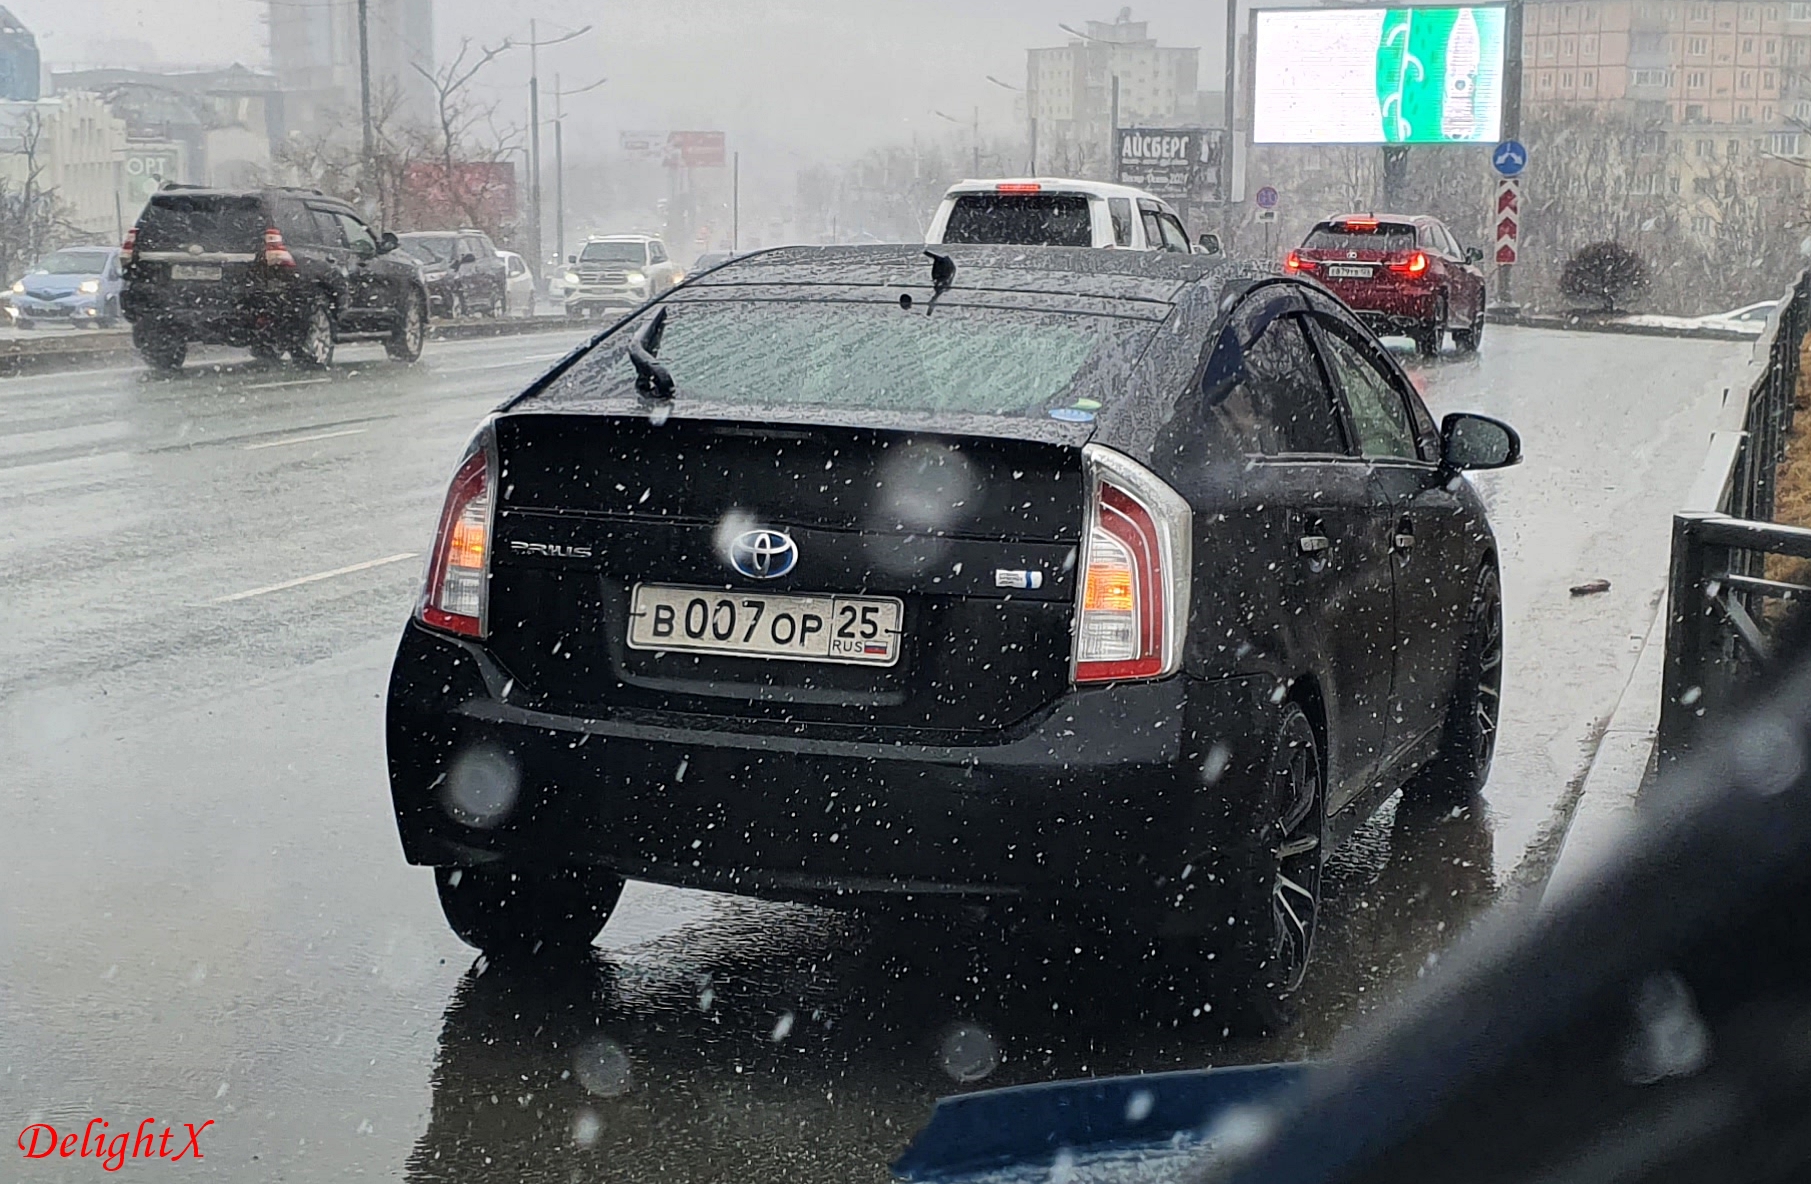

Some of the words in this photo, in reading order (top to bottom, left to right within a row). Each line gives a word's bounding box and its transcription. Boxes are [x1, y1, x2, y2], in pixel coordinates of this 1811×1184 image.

[1122, 132, 1189, 158] АЙСБЕРГ
[510, 541, 593, 558] PRIUS
[836, 605, 880, 640] 25
[832, 639, 864, 654] RUS
